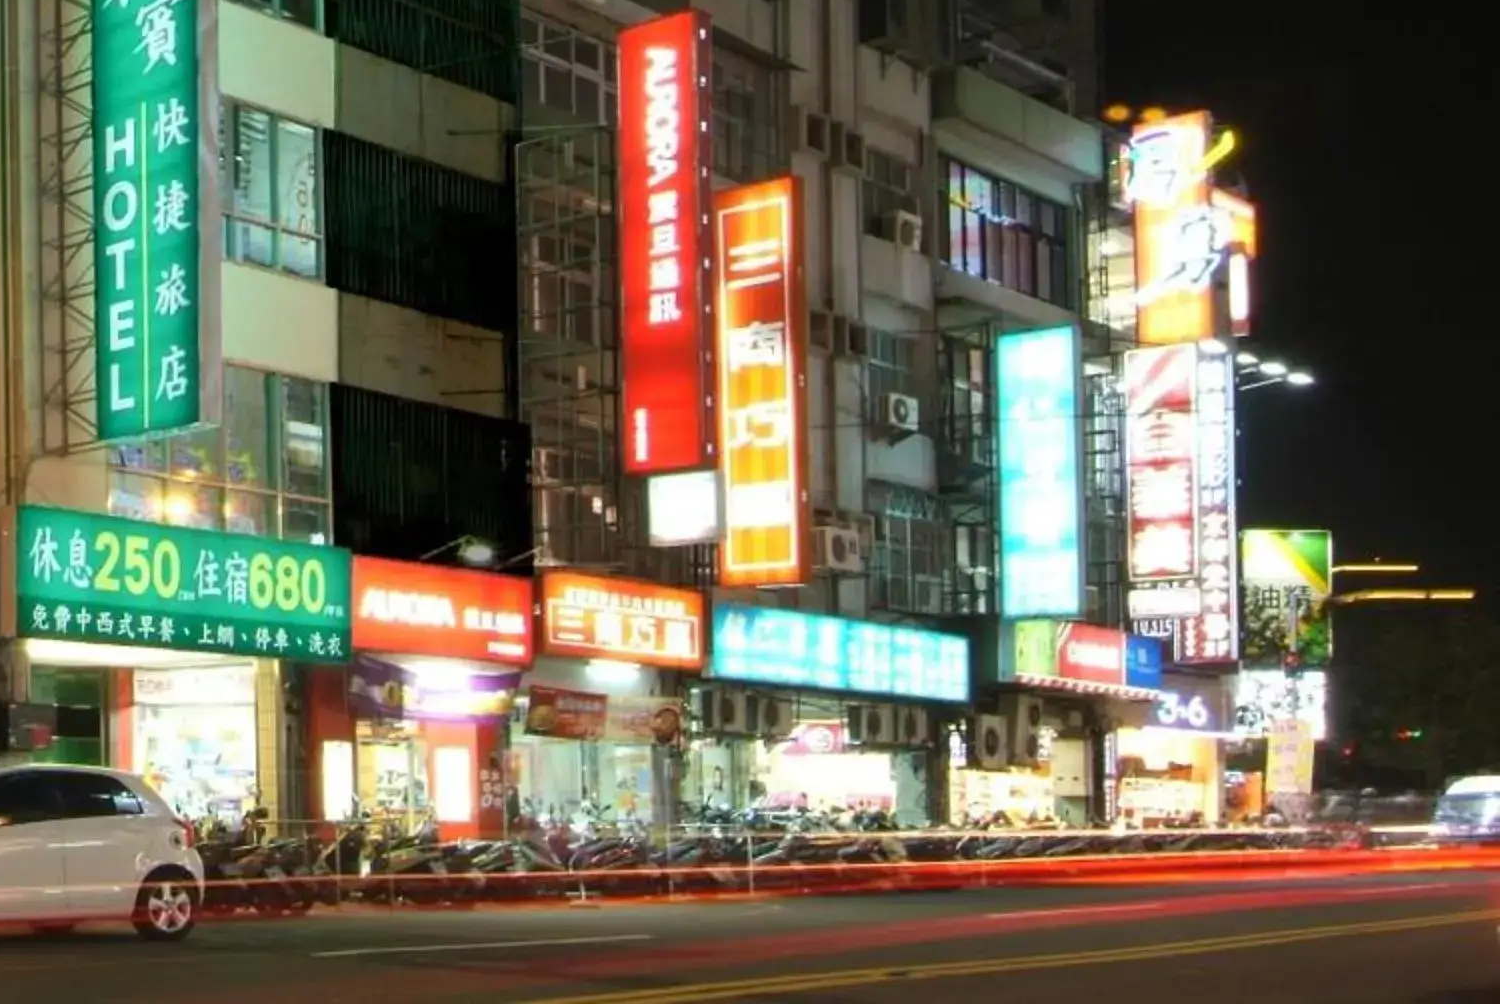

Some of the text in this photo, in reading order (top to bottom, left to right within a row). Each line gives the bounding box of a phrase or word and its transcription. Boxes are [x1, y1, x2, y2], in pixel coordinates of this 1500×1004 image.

[103, 117, 137, 414] HOTEL
[153, 99, 190, 402] 快捷旅店
[727, 238, 792, 527] 三商巧
[29, 527, 92, 589] 休息
[94, 531, 180, 599] 250
[193, 548, 248, 605] 住宿
[249, 552, 325, 614] 680
